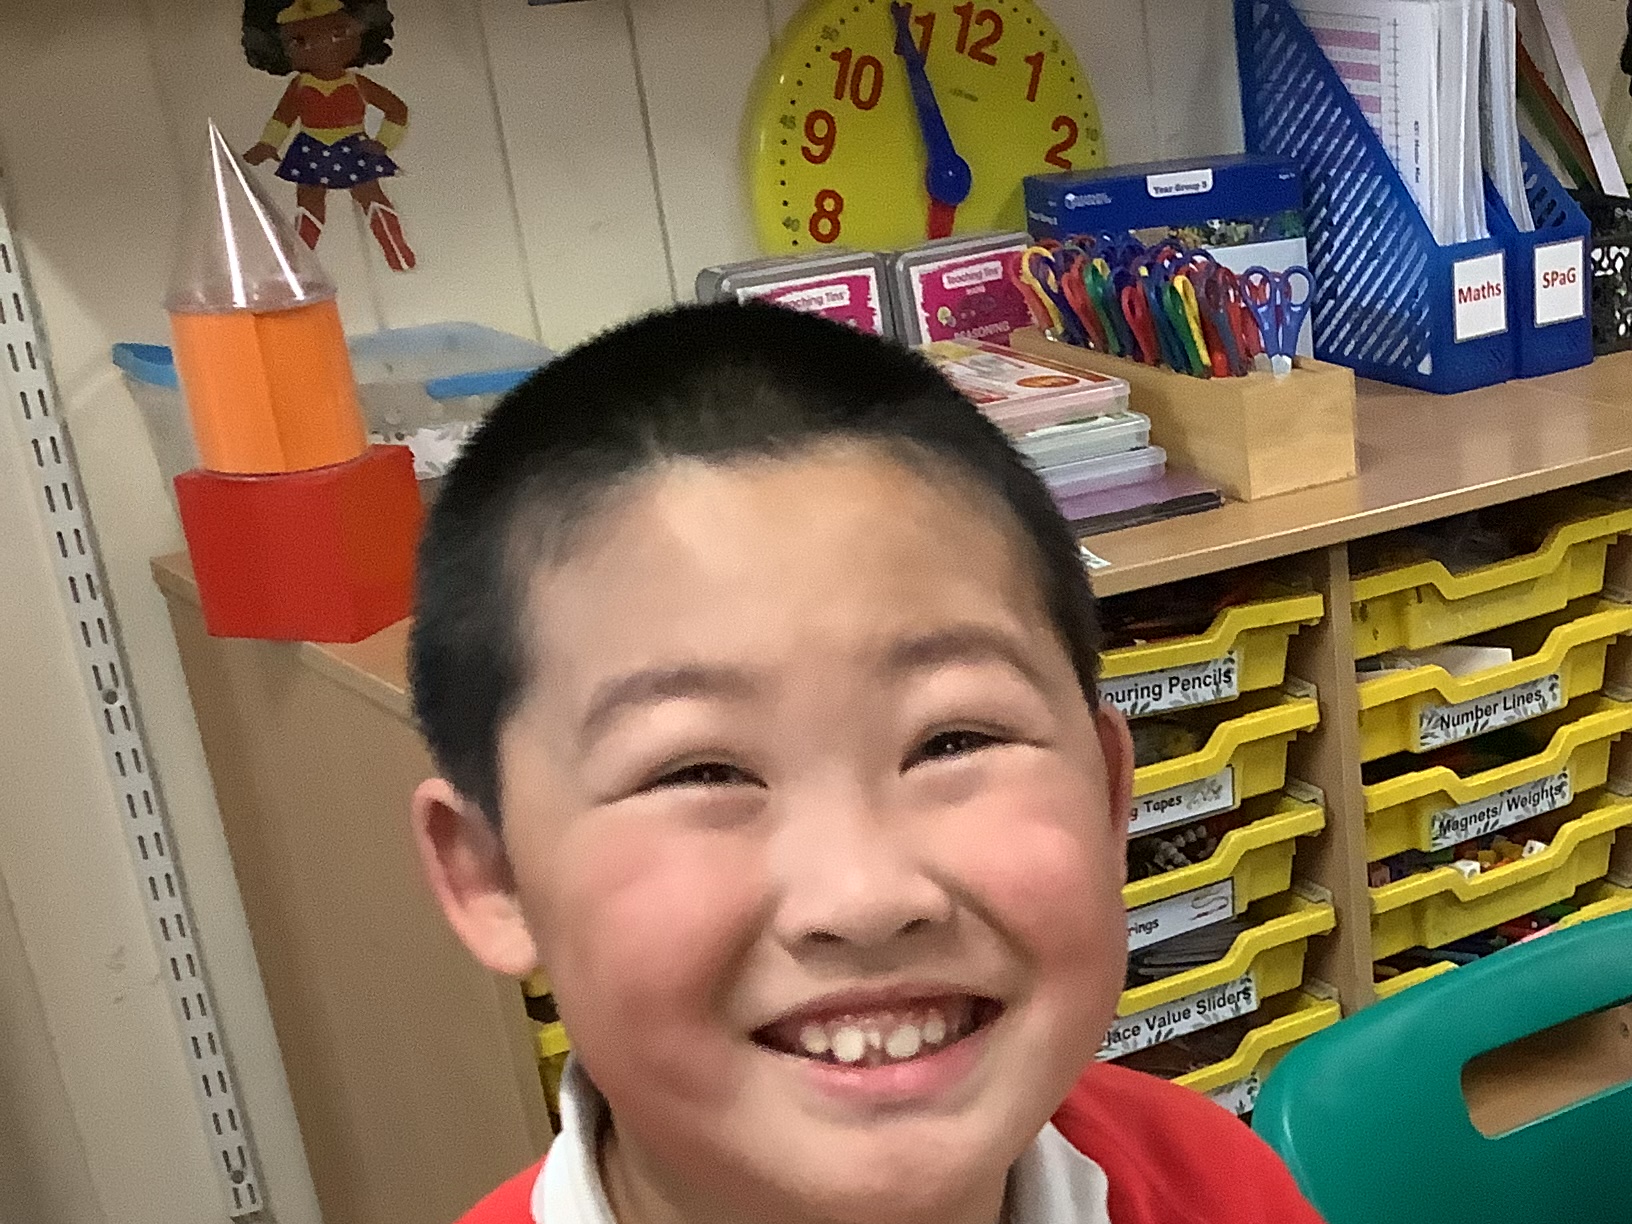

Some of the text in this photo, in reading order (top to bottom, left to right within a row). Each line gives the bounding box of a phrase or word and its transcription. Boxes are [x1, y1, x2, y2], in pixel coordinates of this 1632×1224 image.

[953, 1, 1003, 66] 12
[830, 47, 884, 110] 10
[1024, 52, 1045, 102] 1
[801, 110, 837, 164] 9
[1045, 115, 1079, 170] 2
[1153, 186, 1173, 194] Year
[1175, 183, 1200, 192] Group
[809, 189, 844, 243] 8
[946, 265, 999, 284] Teaching Tins
[1458, 280, 1502, 304] Maths
[1542, 267, 1577, 288] SPaG
[1104, 667, 1232, 704] ouring Pencils
[1440, 689, 1543, 731] Number Lines
[1143, 795, 1183, 813] Tapes
[1506, 783, 1563, 813] Weights
[1128, 918, 1160, 937] rings
[1107, 986, 1252, 1047] lace Value Sliders
